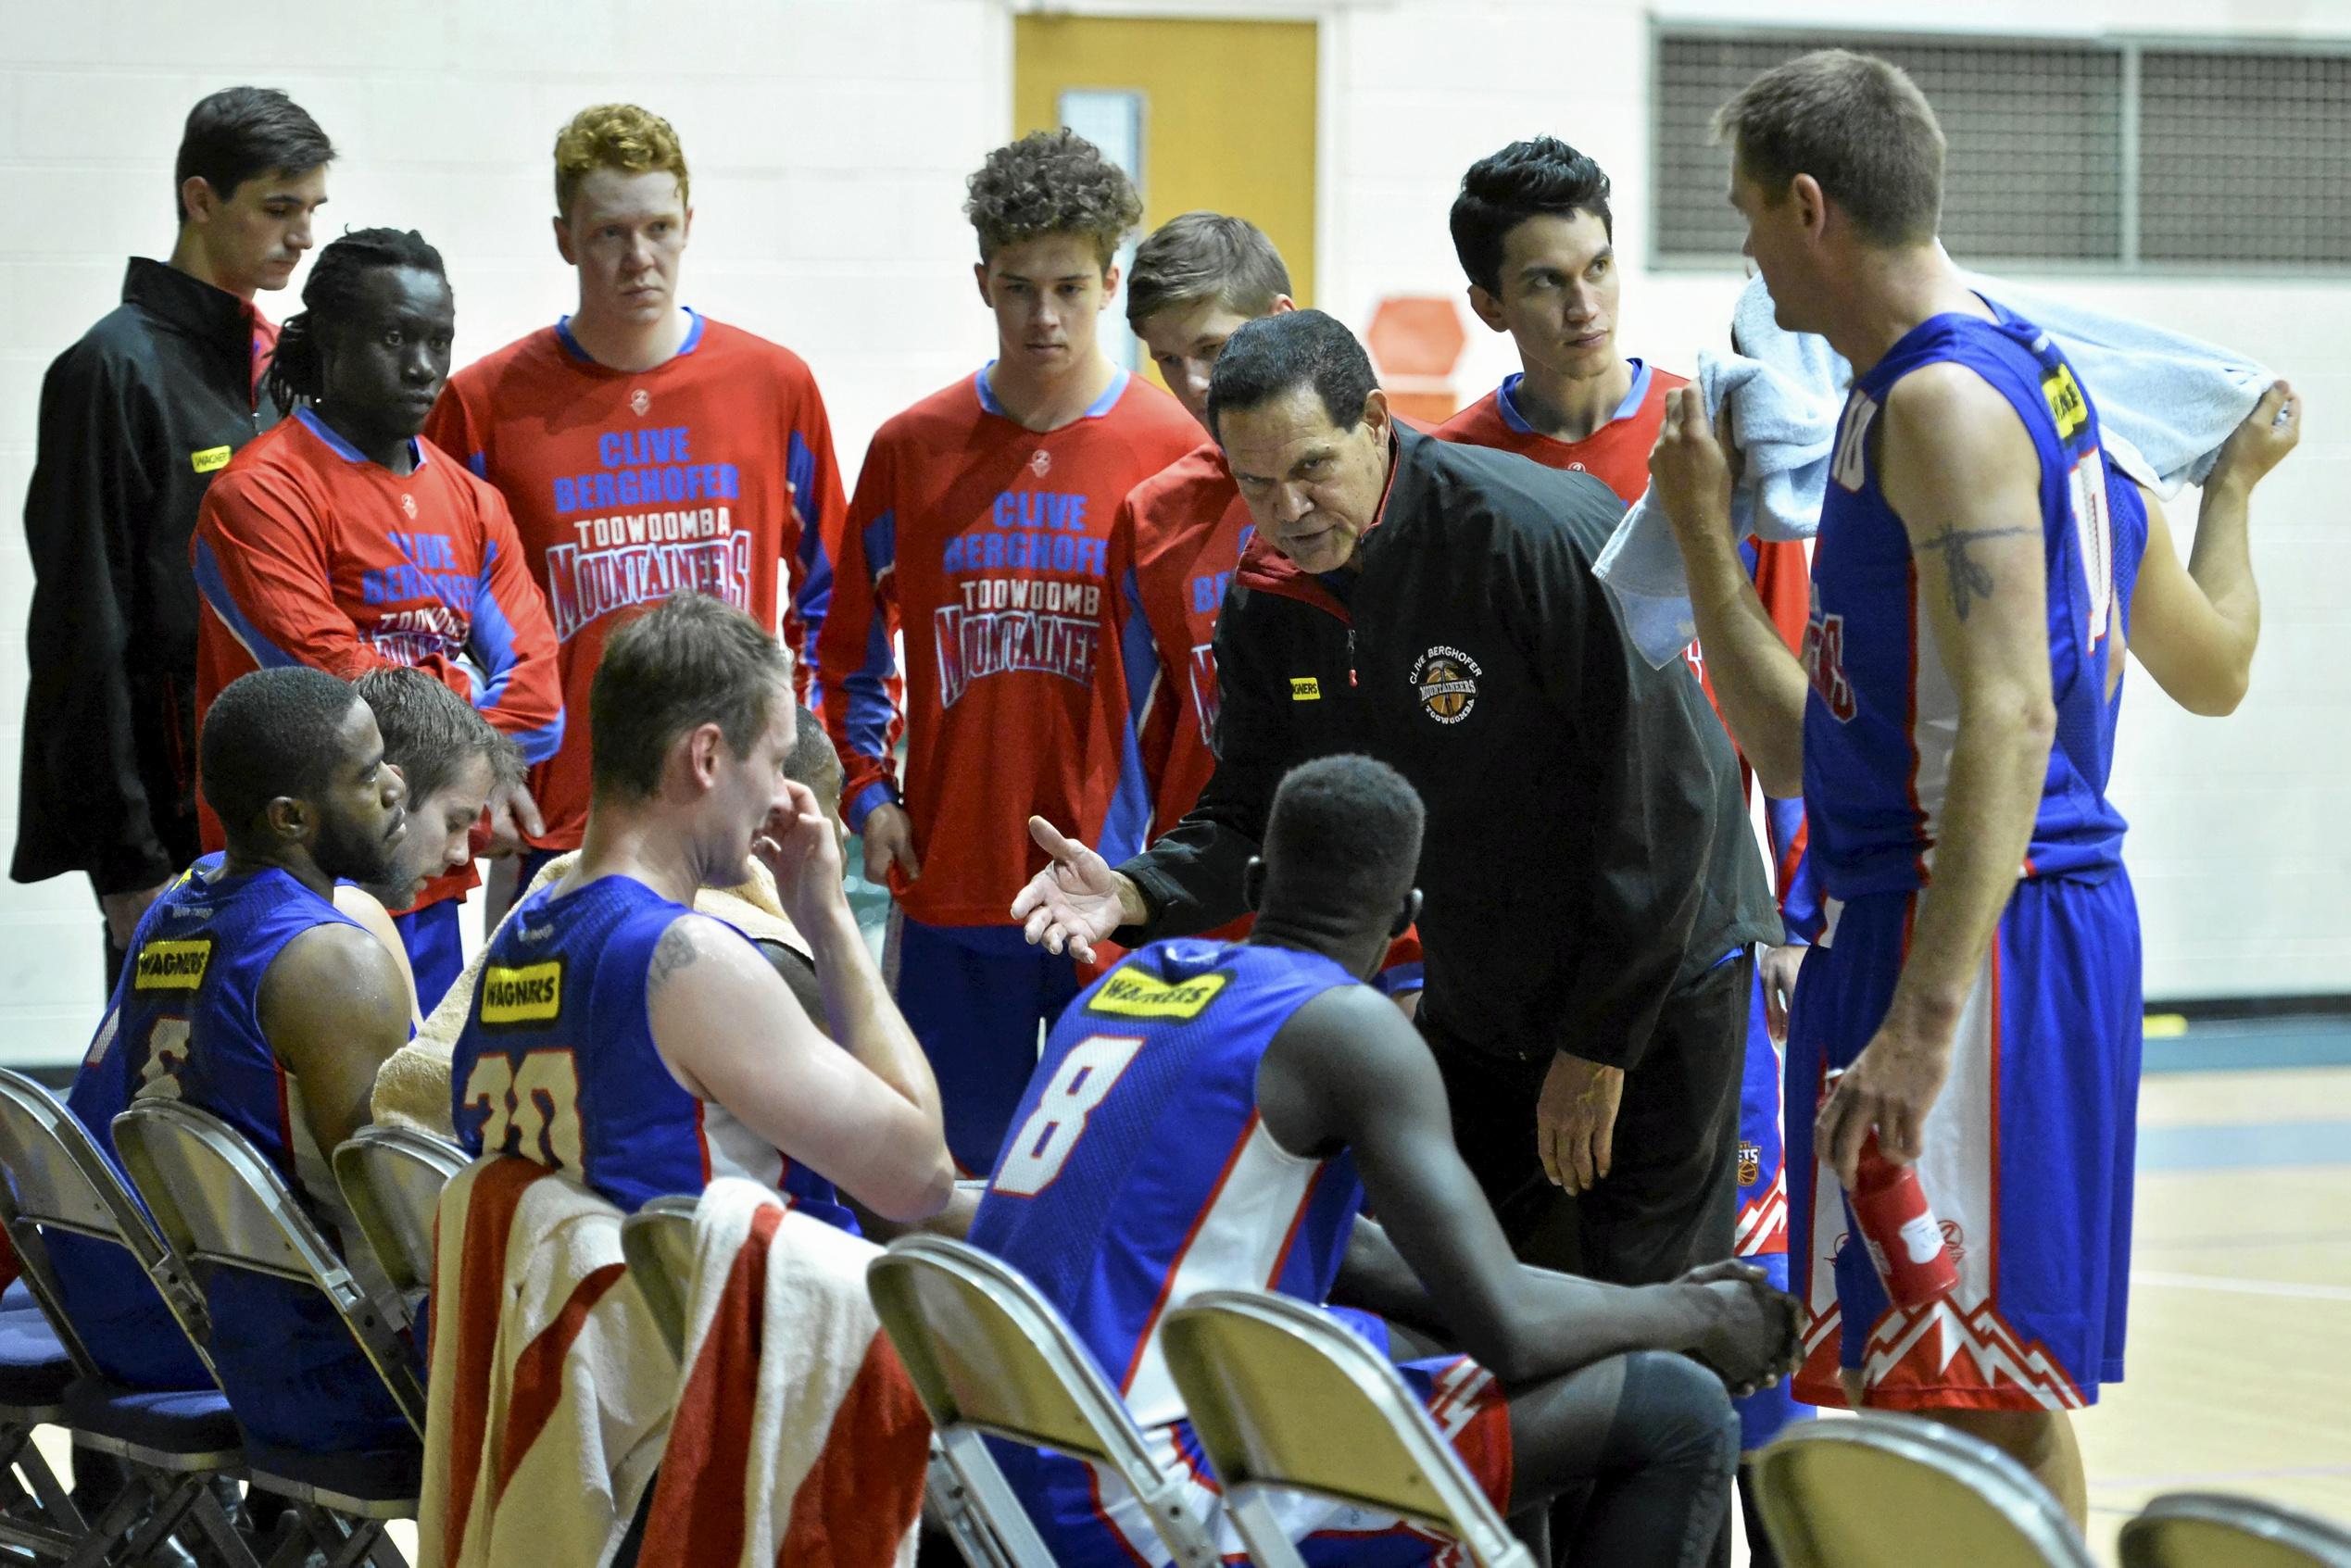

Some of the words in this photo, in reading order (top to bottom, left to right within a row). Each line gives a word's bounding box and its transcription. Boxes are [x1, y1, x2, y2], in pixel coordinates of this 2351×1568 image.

[599, 426, 691, 468] CLIVE
[555, 463, 739, 512] BERGHOFER
[573, 507, 731, 549] TOOWOOMBA
[994, 491, 1087, 532] CLIVE
[943, 532, 1109, 576] BERGHOFE
[960, 578, 1101, 616] TOOWOOMB
[1409, 654, 1427, 684] CLIVE
[1427, 646, 1483, 677] BERGHOFER
[1419, 679, 1477, 702] MOUNTAINEERS
[1426, 698, 1475, 725] TOOWOOMBA
[991, 1034, 1148, 1199] 8
